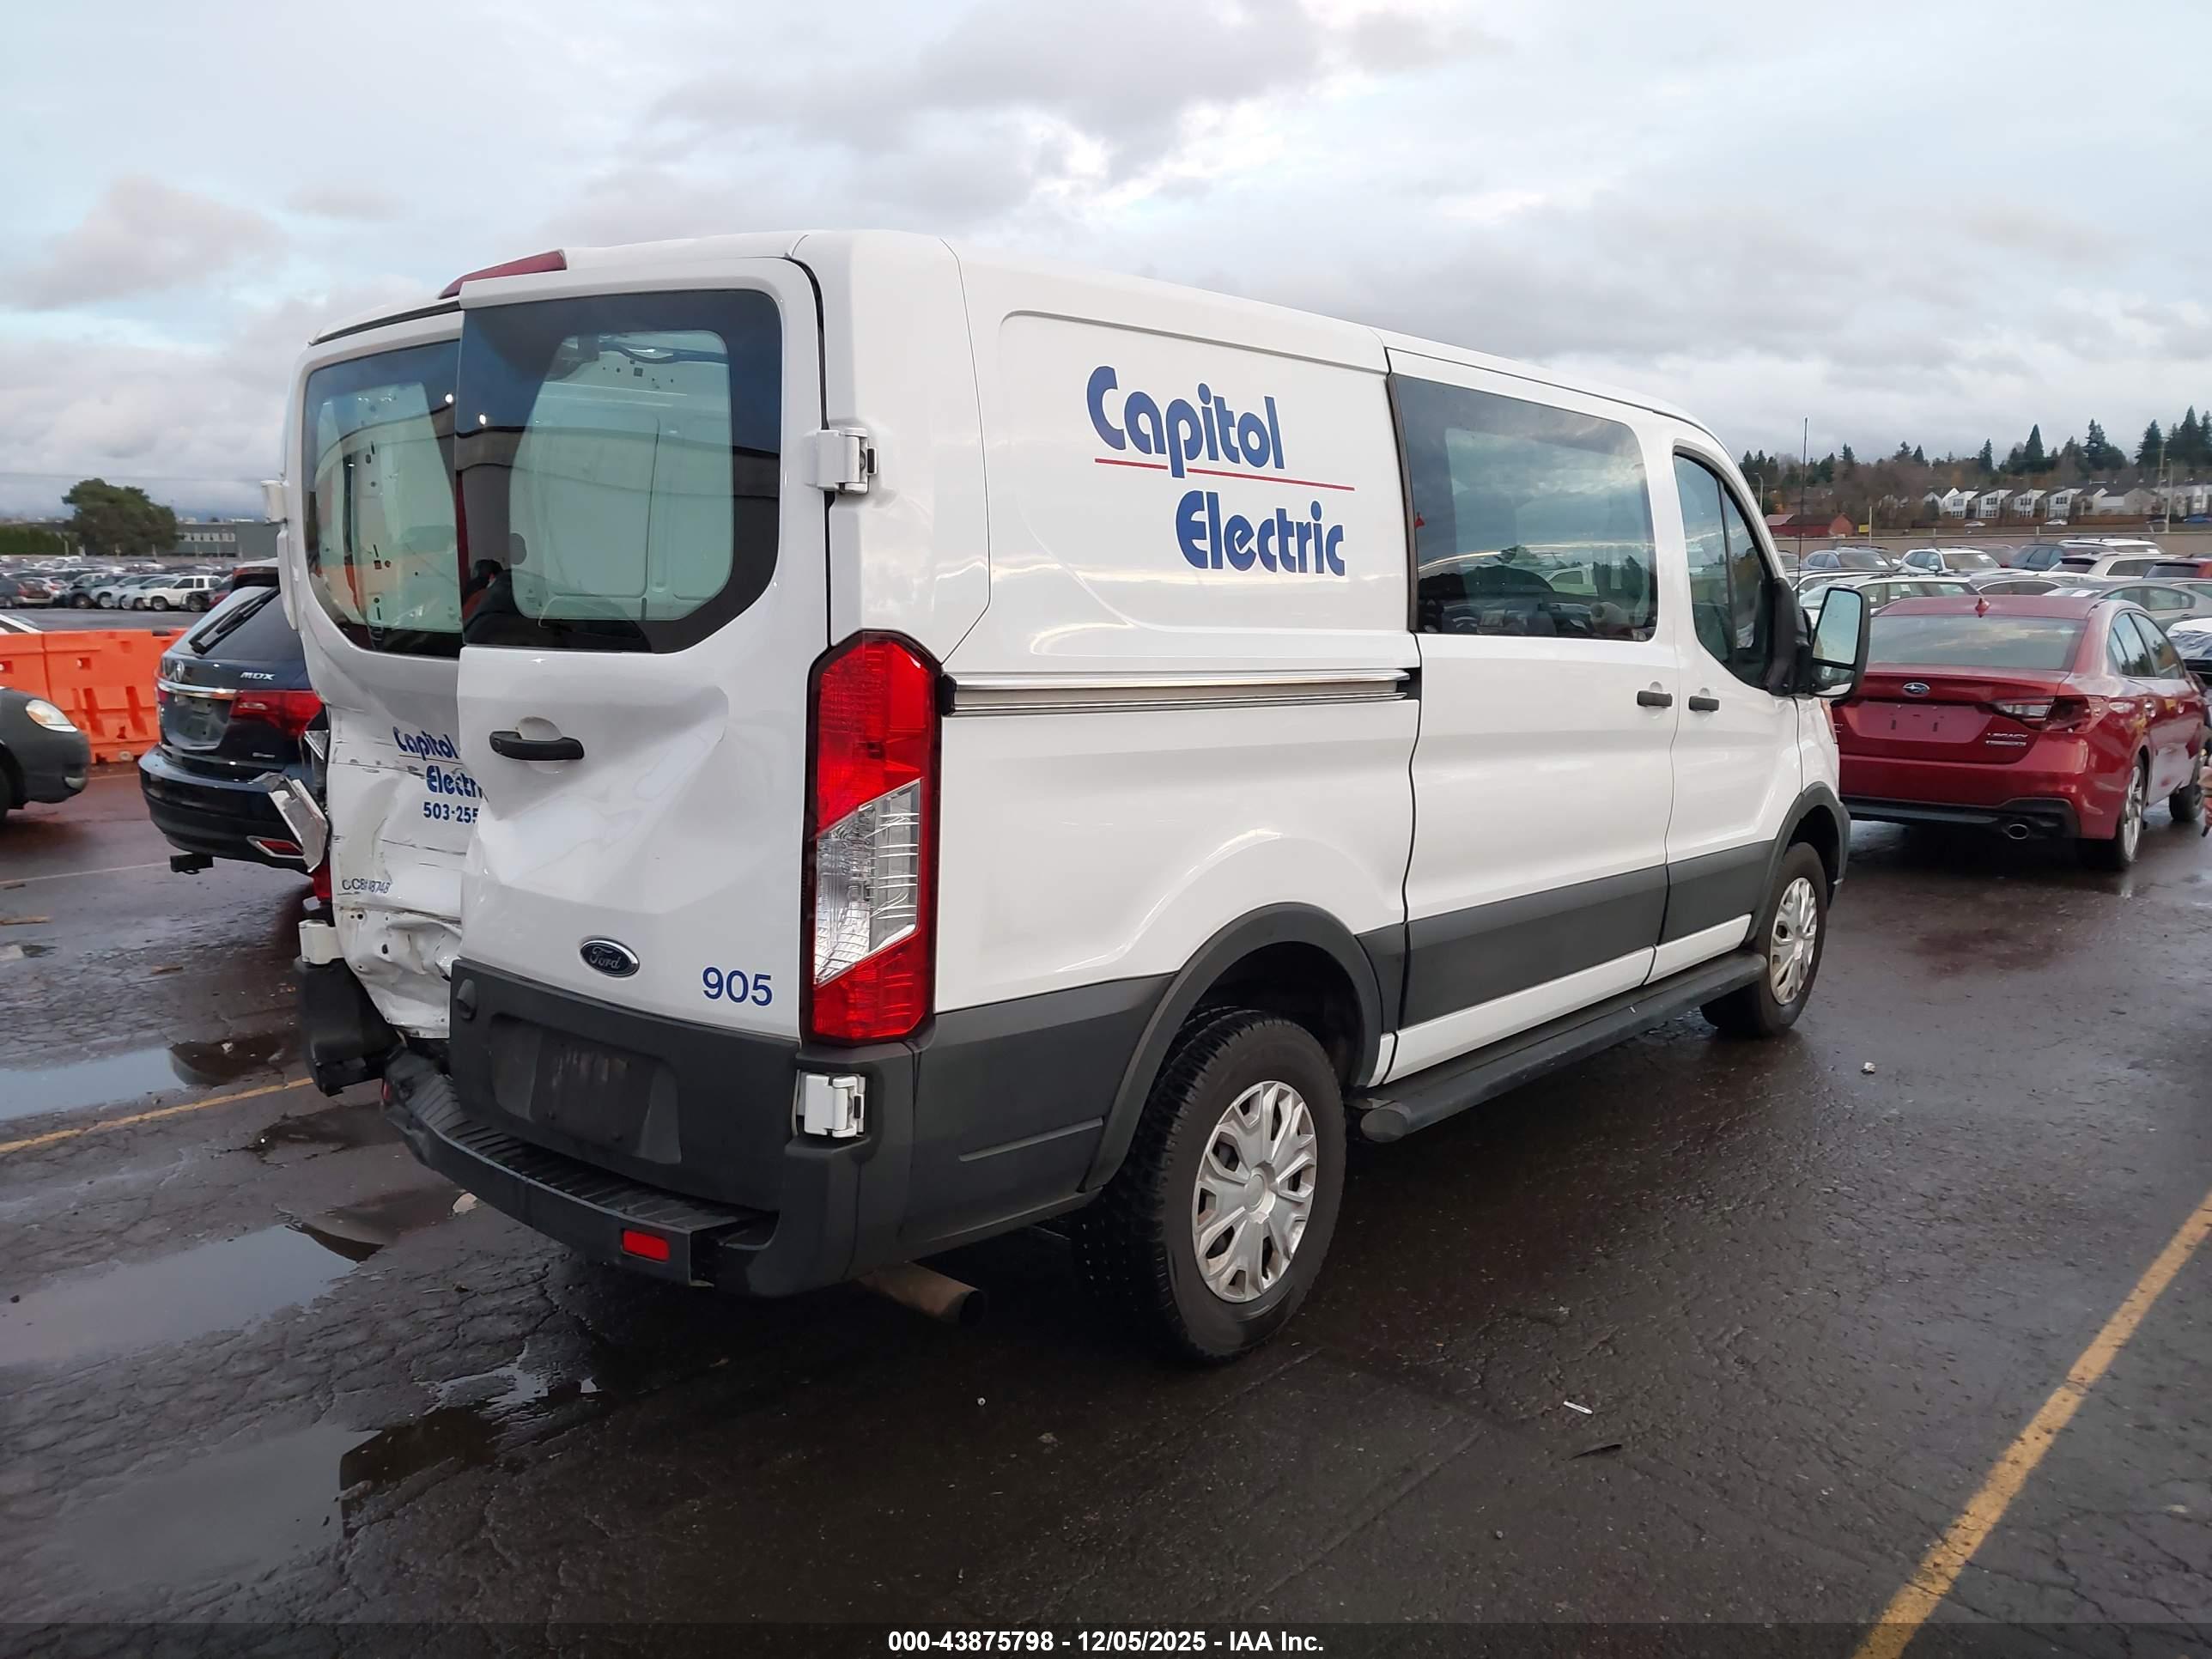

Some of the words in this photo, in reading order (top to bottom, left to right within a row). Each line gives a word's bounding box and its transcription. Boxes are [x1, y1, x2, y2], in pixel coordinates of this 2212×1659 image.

[1087, 365, 1285, 478] Capitol
[1176, 489, 1346, 576] Electric
[240, 672, 276, 681] MDX
[392, 726, 459, 761] Capitol
[589, 945, 622, 970] Ford
[702, 966, 773, 1006] 905
